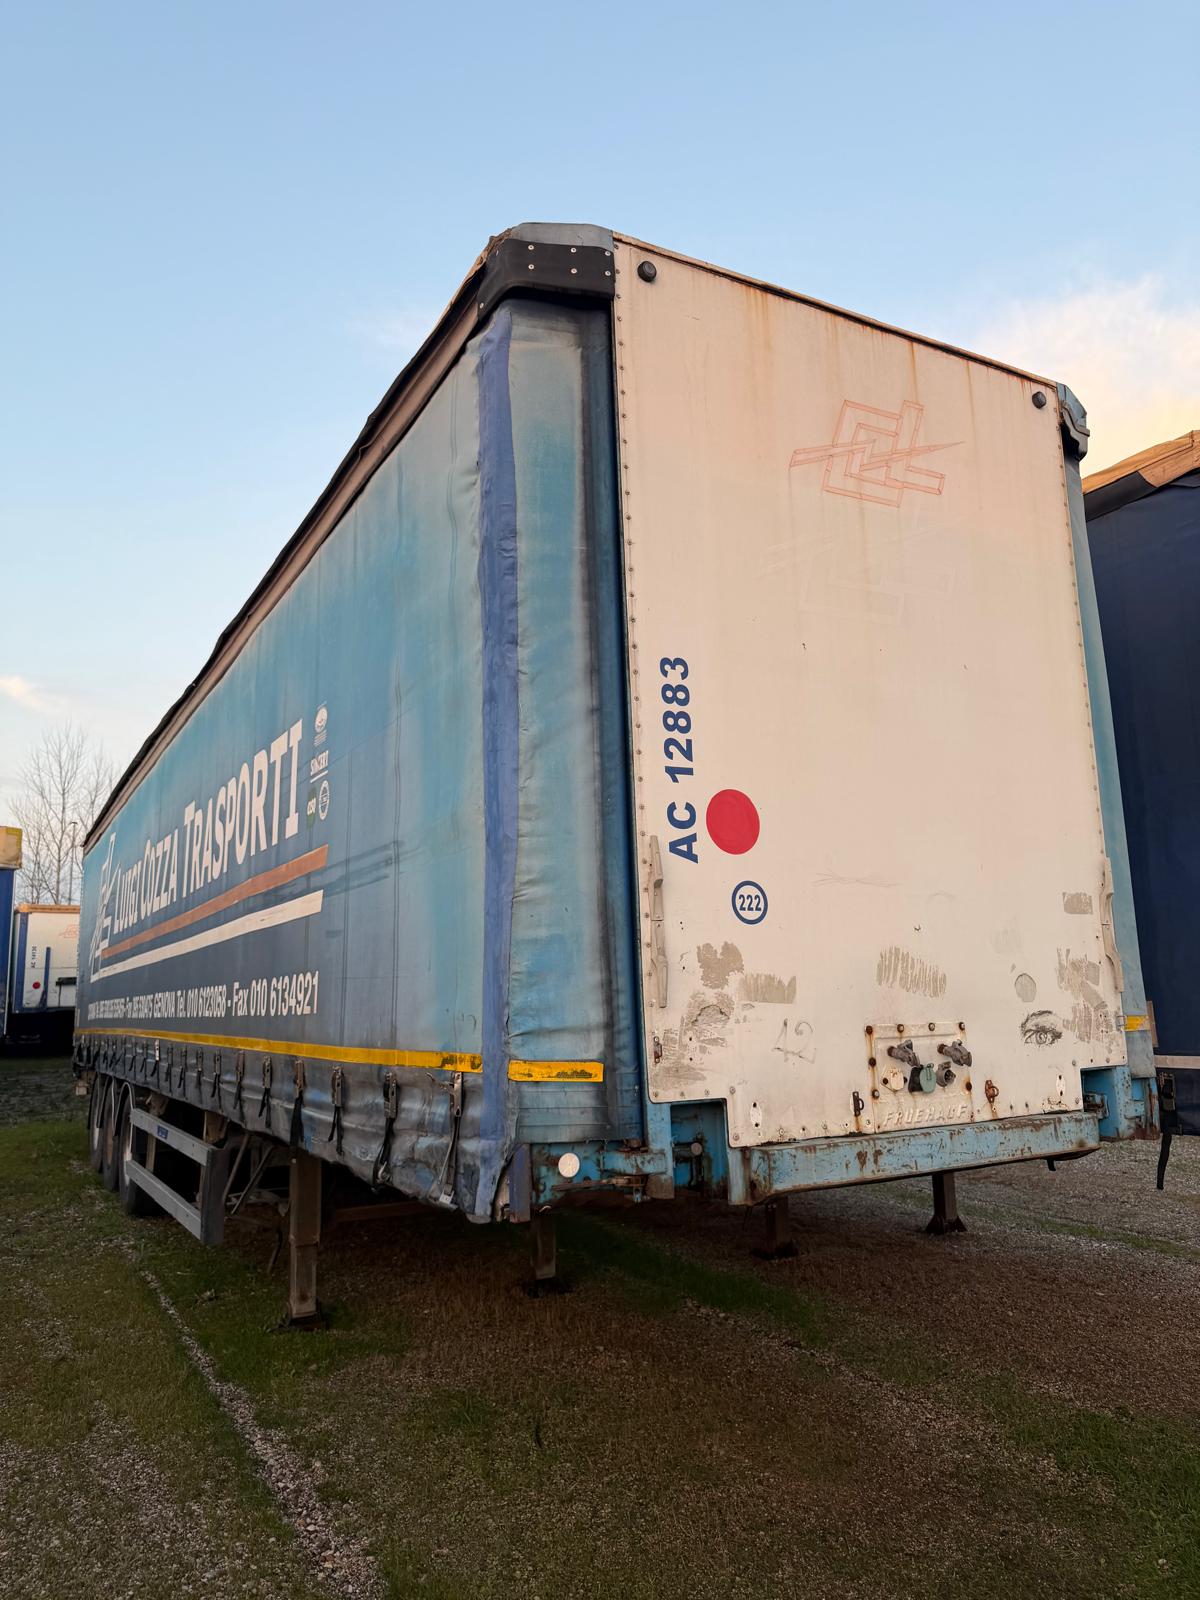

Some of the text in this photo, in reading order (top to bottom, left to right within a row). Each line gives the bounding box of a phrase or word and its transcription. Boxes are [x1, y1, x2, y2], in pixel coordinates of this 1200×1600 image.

[659, 656, 699, 864] AC 12883
[113, 859, 142, 934] LUIGI
[140, 828, 179, 918] COZZA
[182, 719, 303, 898] TRASPORTI
[738, 894, 762, 912] 222
[153, 992, 176, 1018] GENOVA
[187, 987, 198, 1018] 010
[232, 981, 249, 1017] Fax
[250, 978, 268, 1017] 010
[269, 970, 319, 1017] 6134921
[883, 1103, 968, 1128] FRUEHAUF
